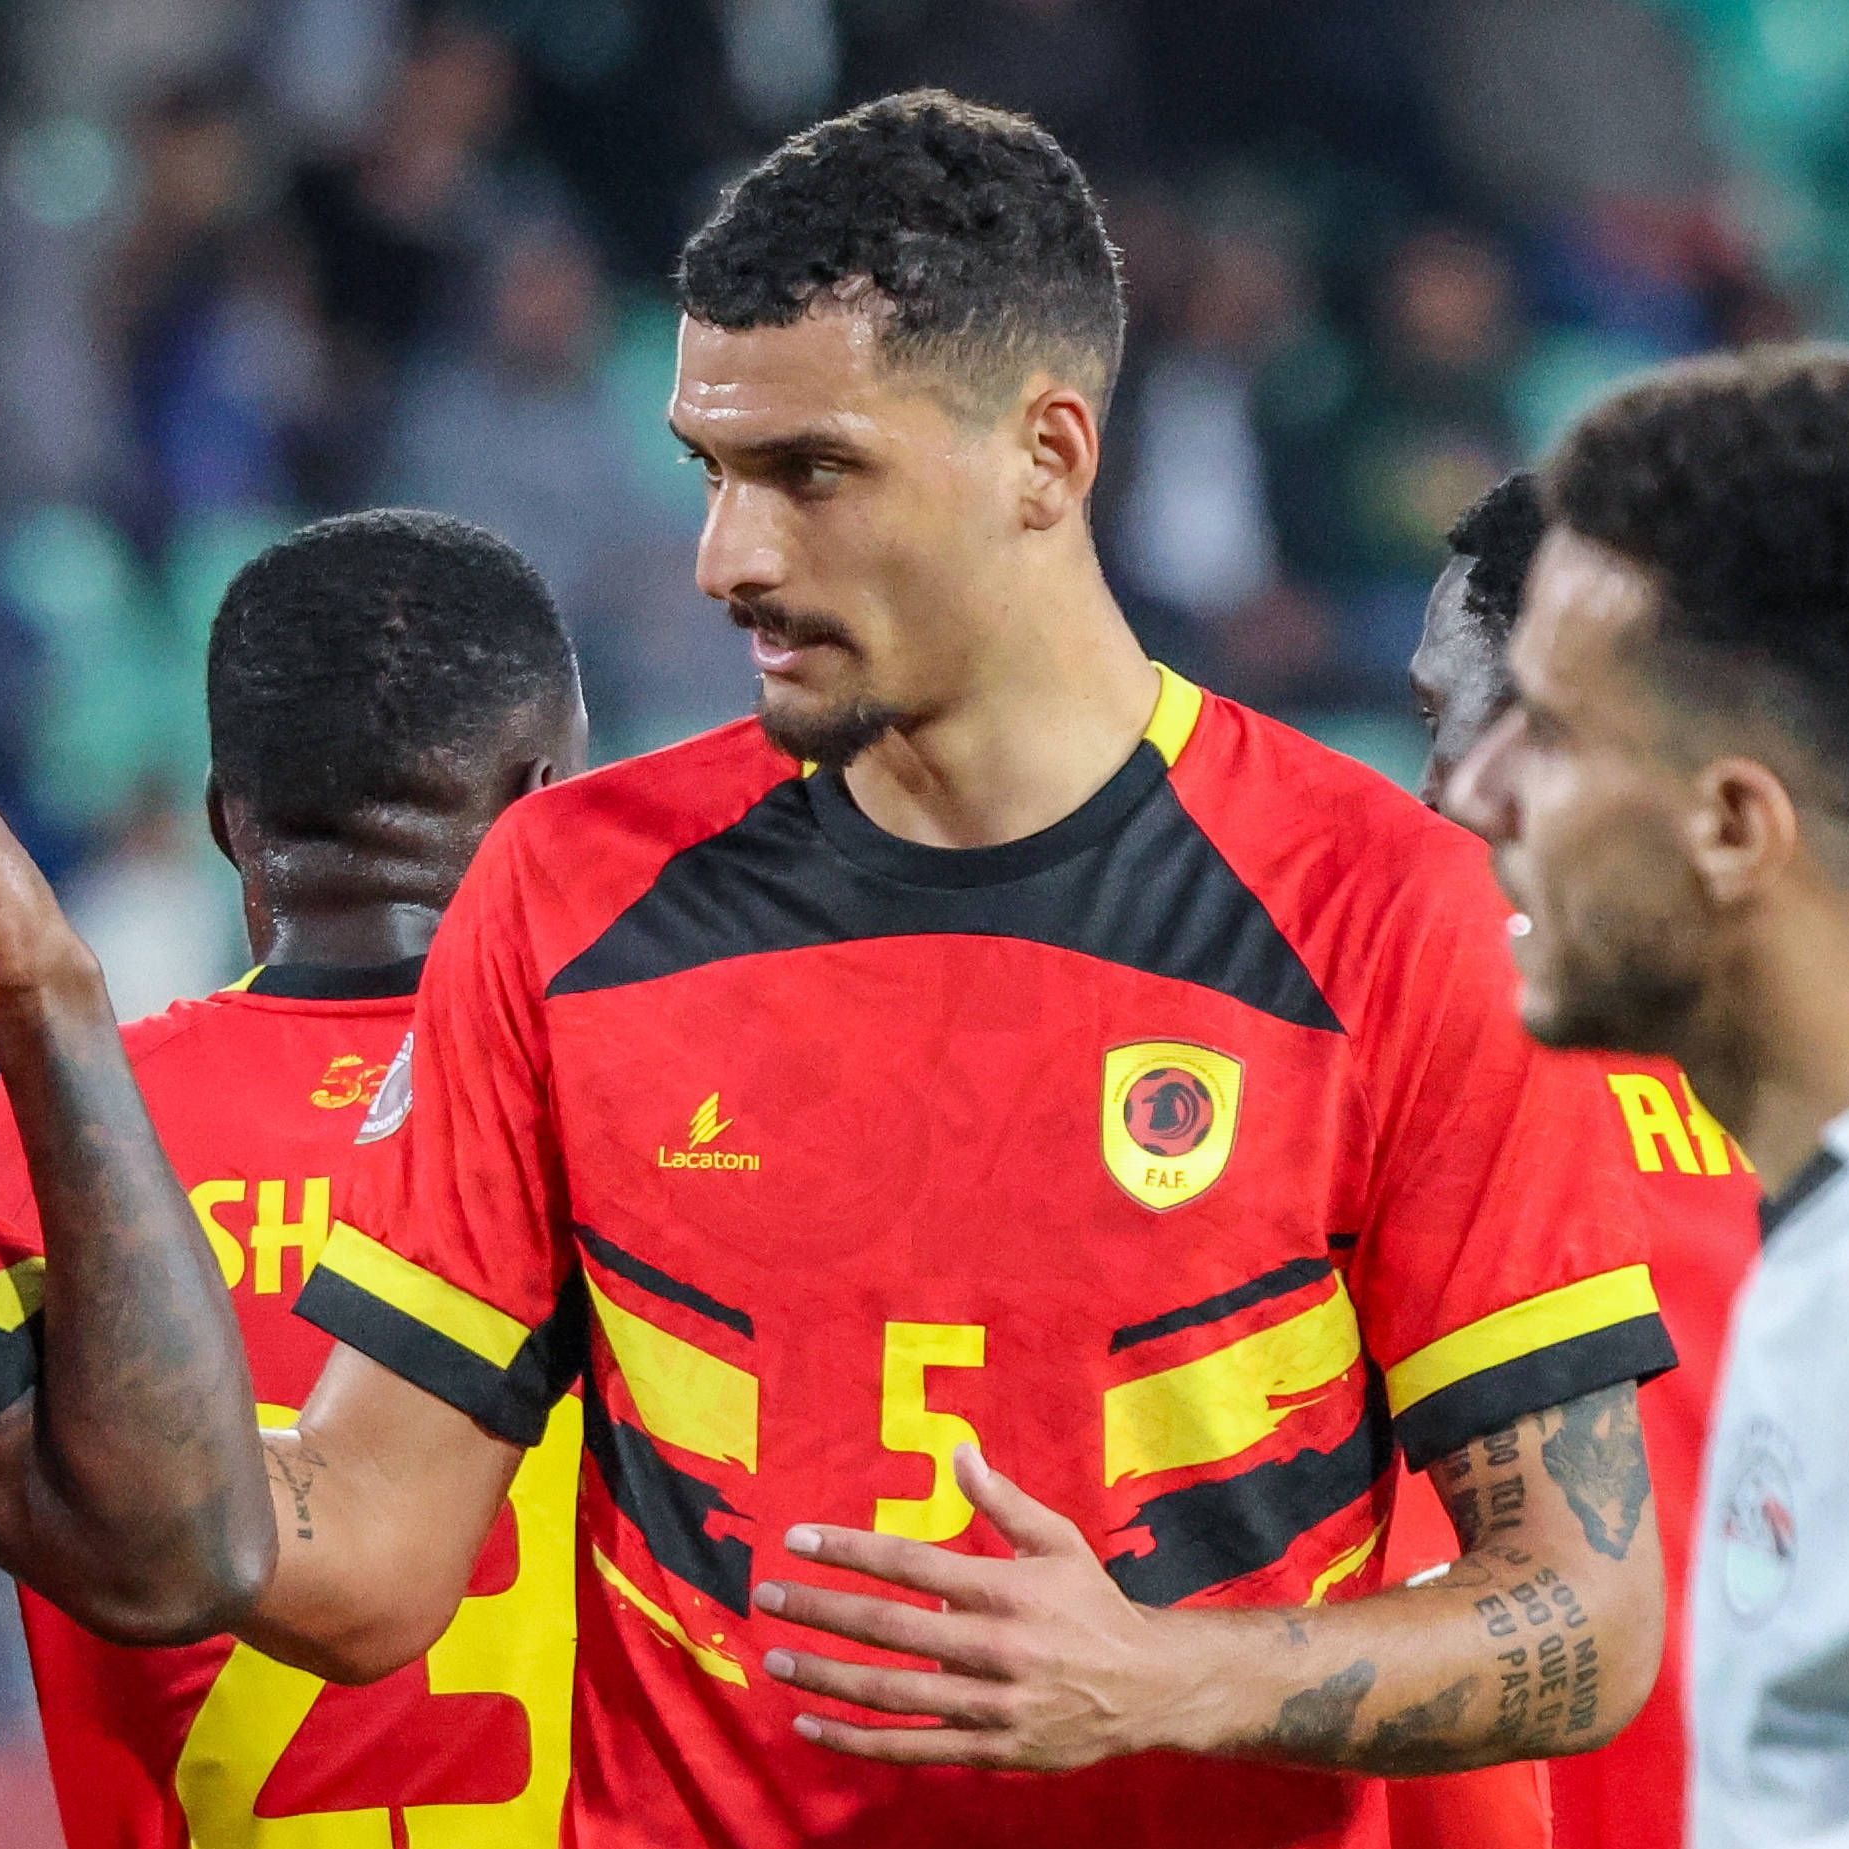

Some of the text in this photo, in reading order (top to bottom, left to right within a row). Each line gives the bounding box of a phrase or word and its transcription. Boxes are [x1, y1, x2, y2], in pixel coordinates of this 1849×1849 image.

[658, 1145, 761, 1171] Lacatoni
[874, 1320, 986, 1544] 5
[1474, 1594, 1518, 1637] EU
[1509, 1582, 1552, 1626] DO
[1538, 1632, 1569, 1698] QUE
